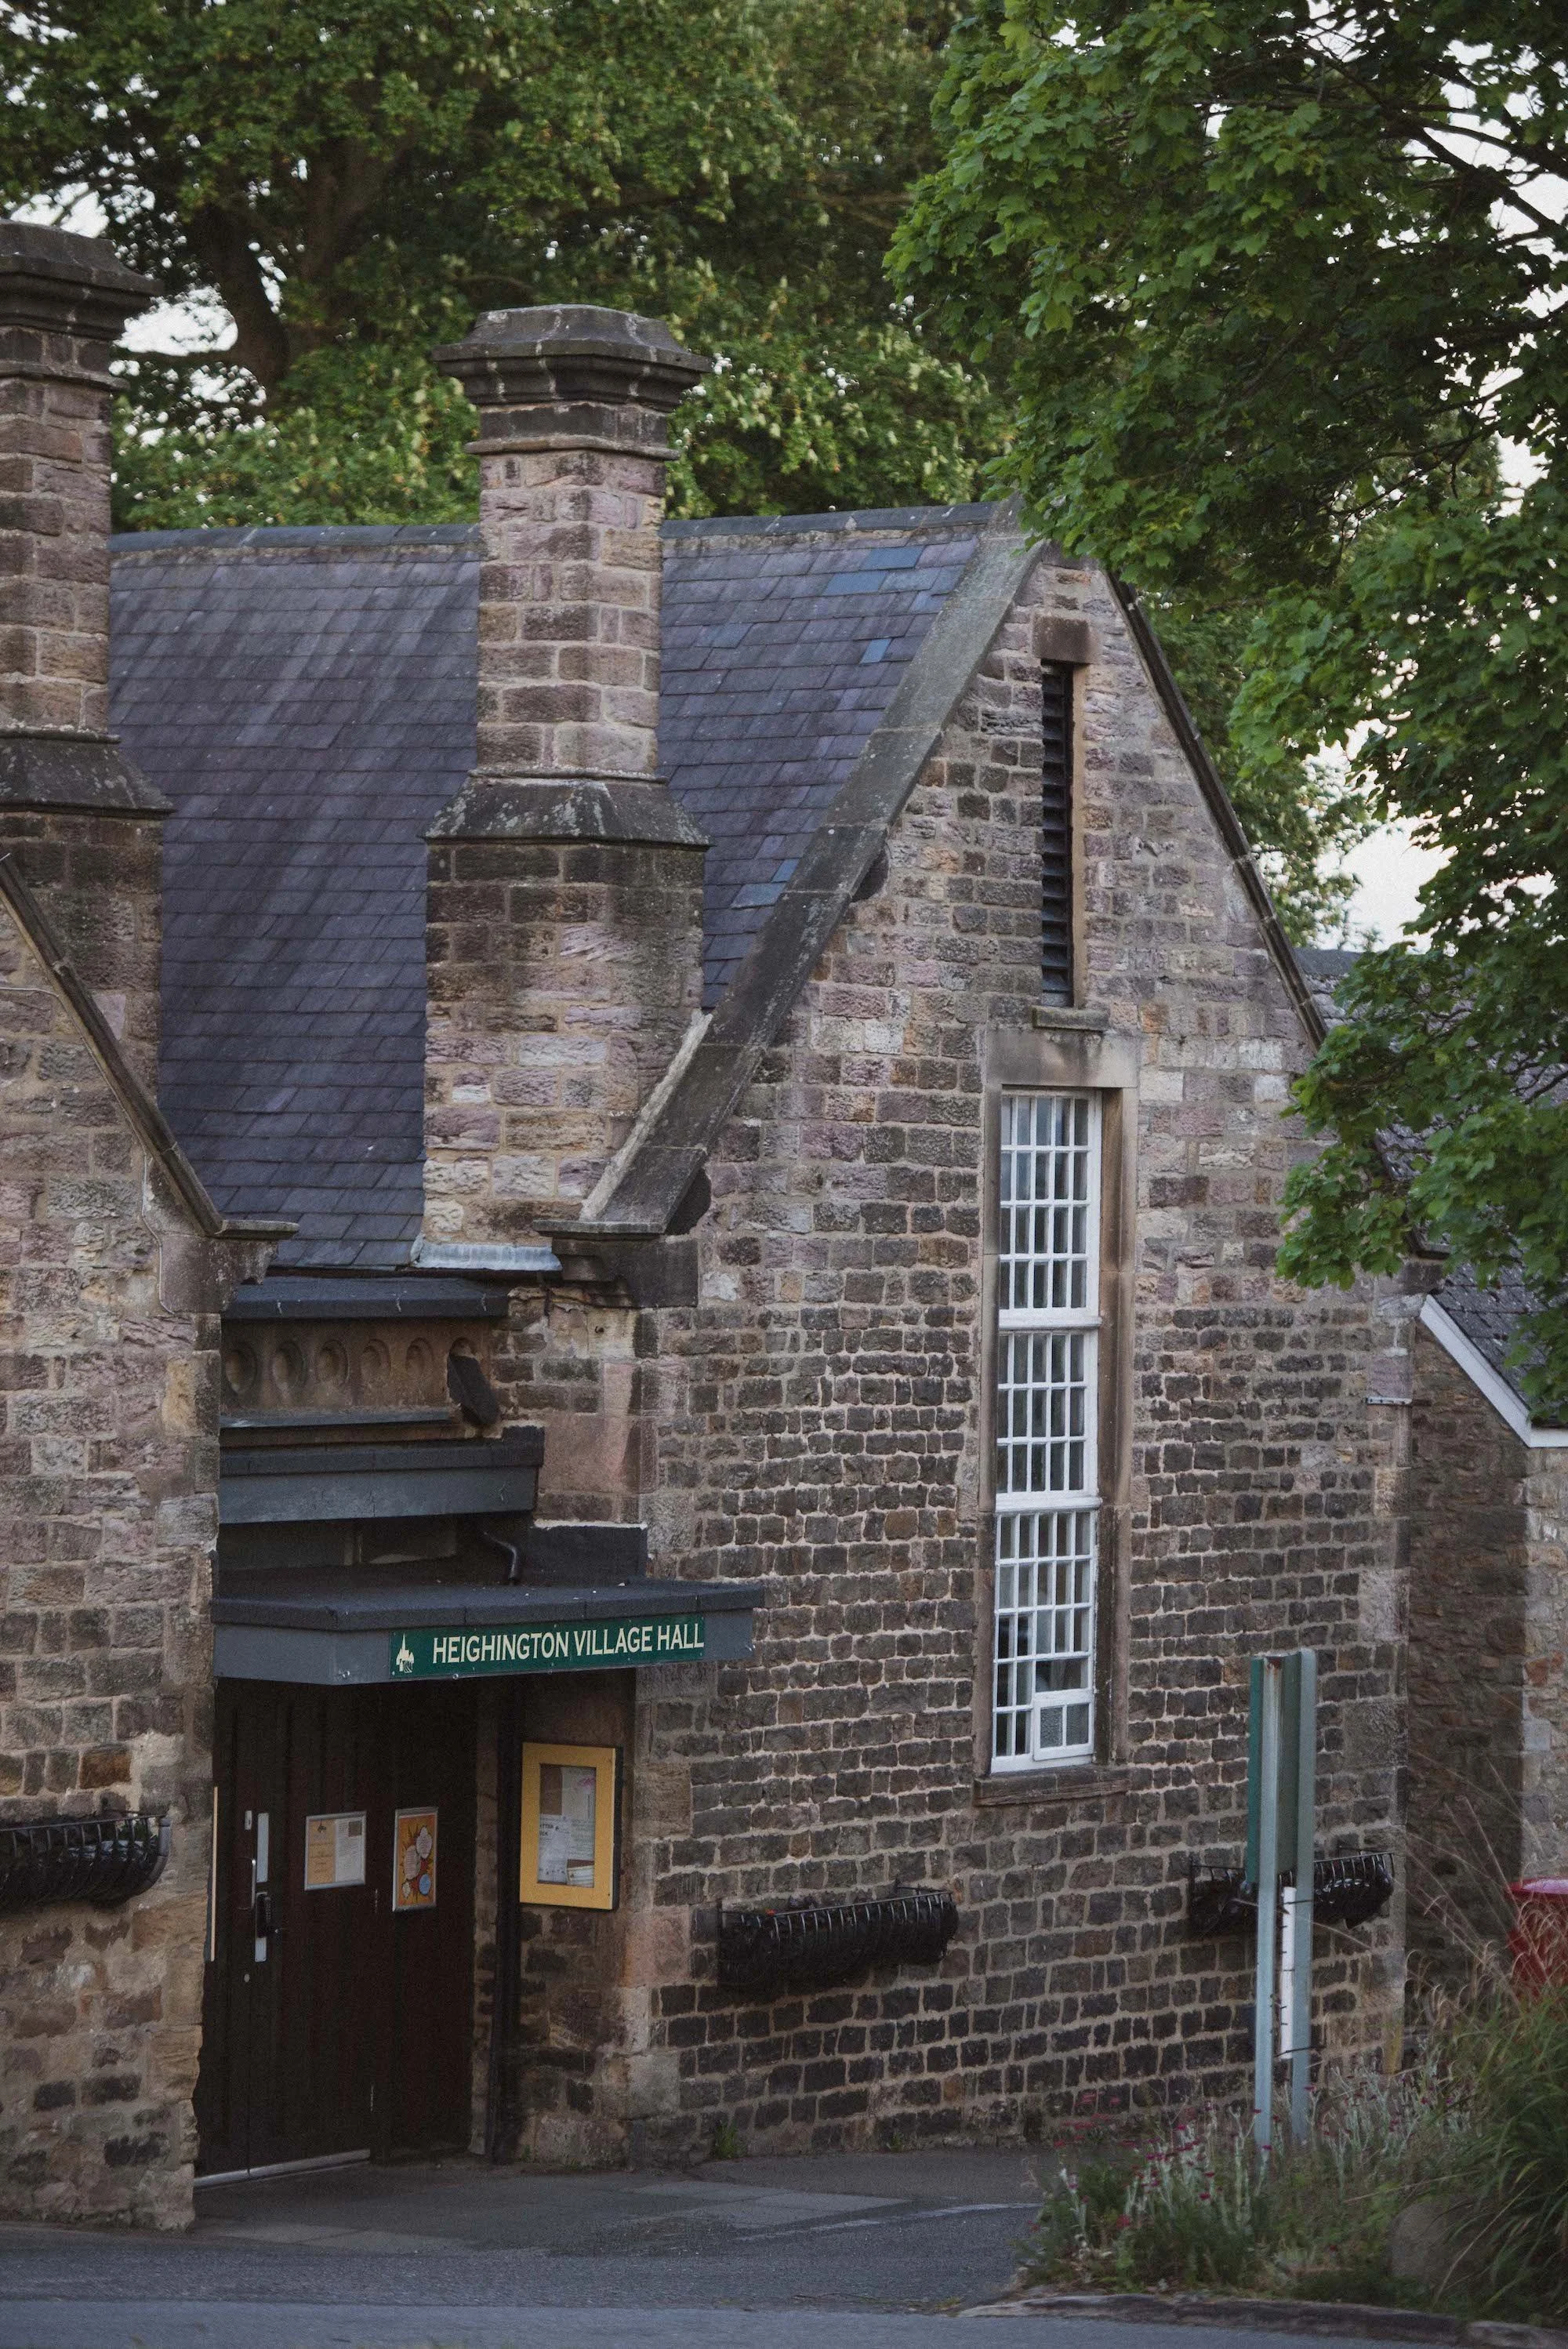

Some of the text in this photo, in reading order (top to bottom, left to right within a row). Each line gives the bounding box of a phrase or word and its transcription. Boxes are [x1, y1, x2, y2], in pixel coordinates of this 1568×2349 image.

[433, 1624, 705, 1664] HEIGHINGTON VILLAGE HALL
